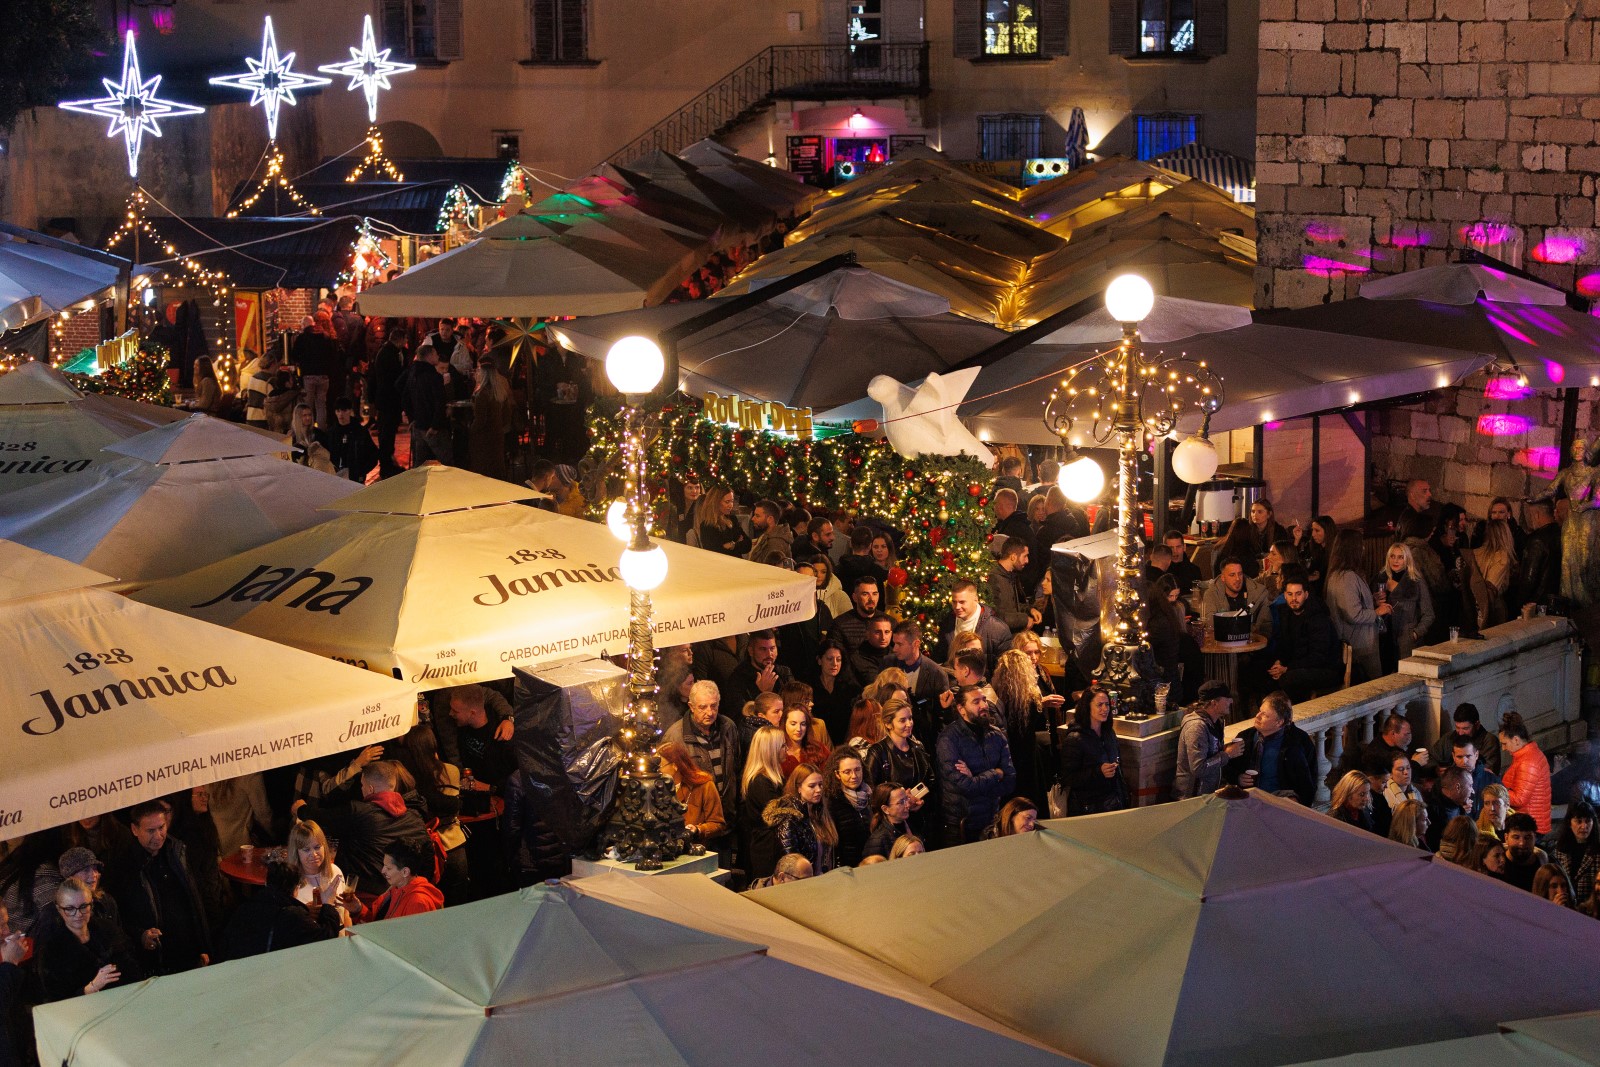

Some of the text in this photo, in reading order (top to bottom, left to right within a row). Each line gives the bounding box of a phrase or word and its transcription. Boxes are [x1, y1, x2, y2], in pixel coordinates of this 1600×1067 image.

[506, 548, 567, 566] 1828
[472, 563, 621, 606] Jamnic
[767, 589, 785, 601] 1828
[747, 599, 802, 624] Jamnica
[500, 638, 579, 663] CARBONATED
[651, 619, 686, 636] NERAL
[687, 612, 726, 628] WATER
[62, 648, 134, 676] 1828
[436, 648, 457, 660] 1828
[411, 659, 478, 684] Jamnica
[21, 665, 237, 736] Jamnica
[361, 702, 381, 716] 1828
[338, 713, 401, 744] Jamnica
[49, 732, 314, 809] CARBONATED NATURAL MINERAL WATER
